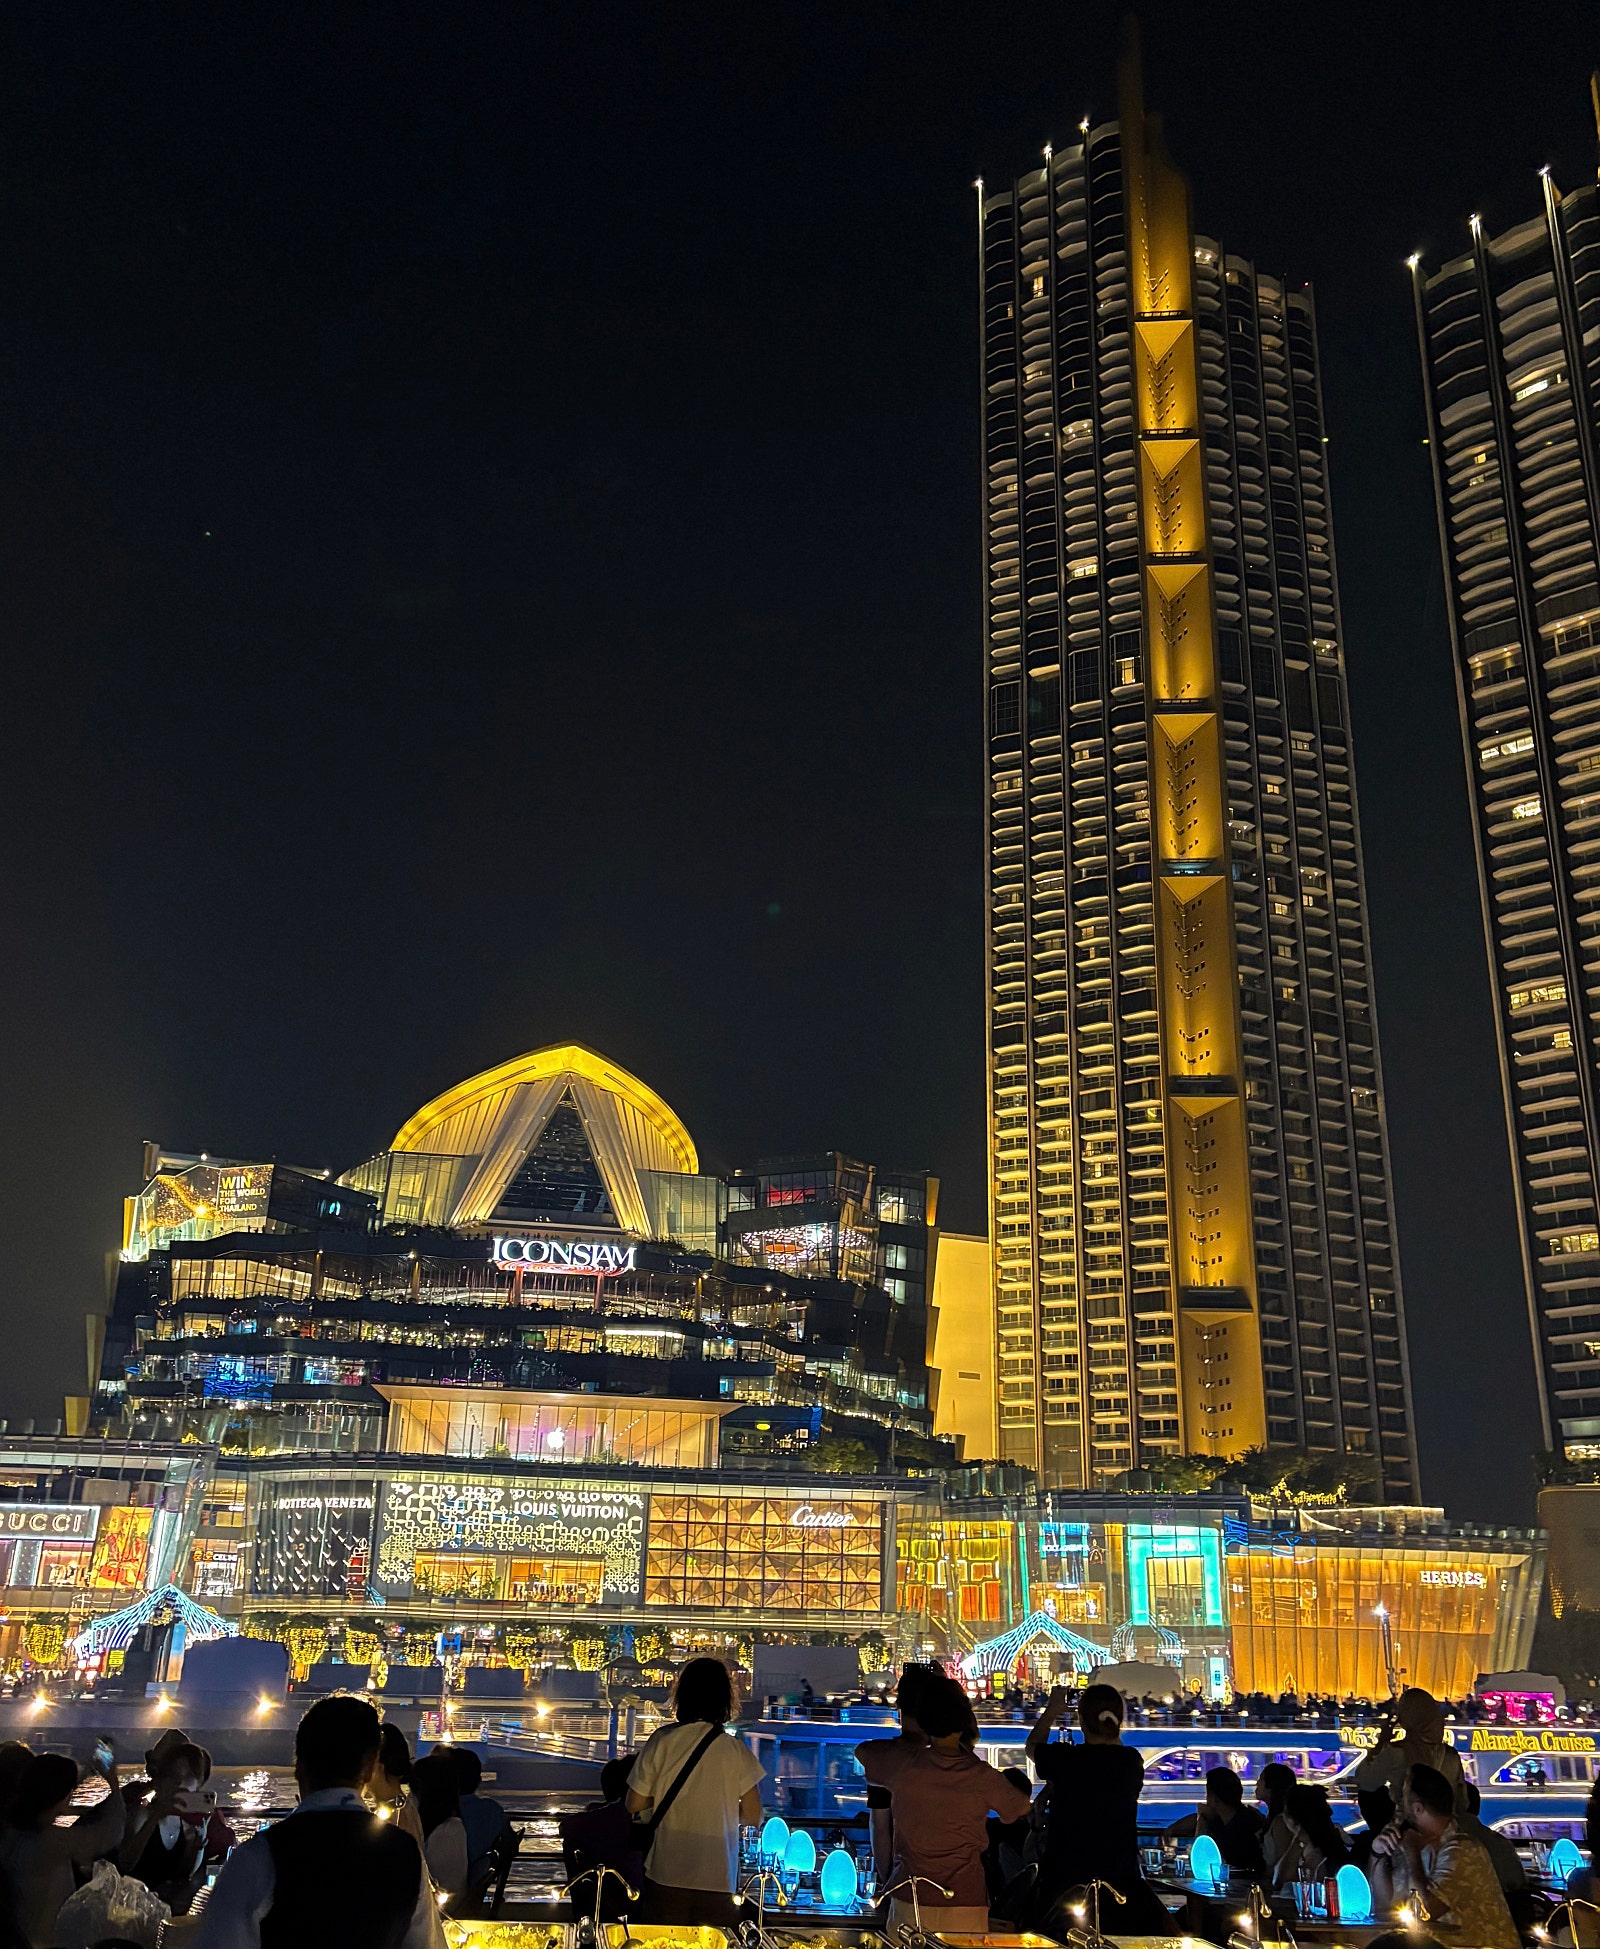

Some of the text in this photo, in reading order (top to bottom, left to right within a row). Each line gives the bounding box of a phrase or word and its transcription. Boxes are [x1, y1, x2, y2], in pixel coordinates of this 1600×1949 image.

[222, 1176, 251, 1190] WIN
[237, 1188, 265, 1197] WORLD
[219, 1197, 236, 1205] FOR
[219, 1203, 257, 1213] THAILAND
[492, 1238, 637, 1271] ICONSIAM
[279, 1497, 372, 1509] BOTTEGA VENETA
[514, 1502, 624, 1519] LOUIS VUITTON
[791, 1506, 854, 1527] Cartier
[1471, 1729, 1541, 1755] Alangka
[1541, 1731, 1595, 1751] Cruise
